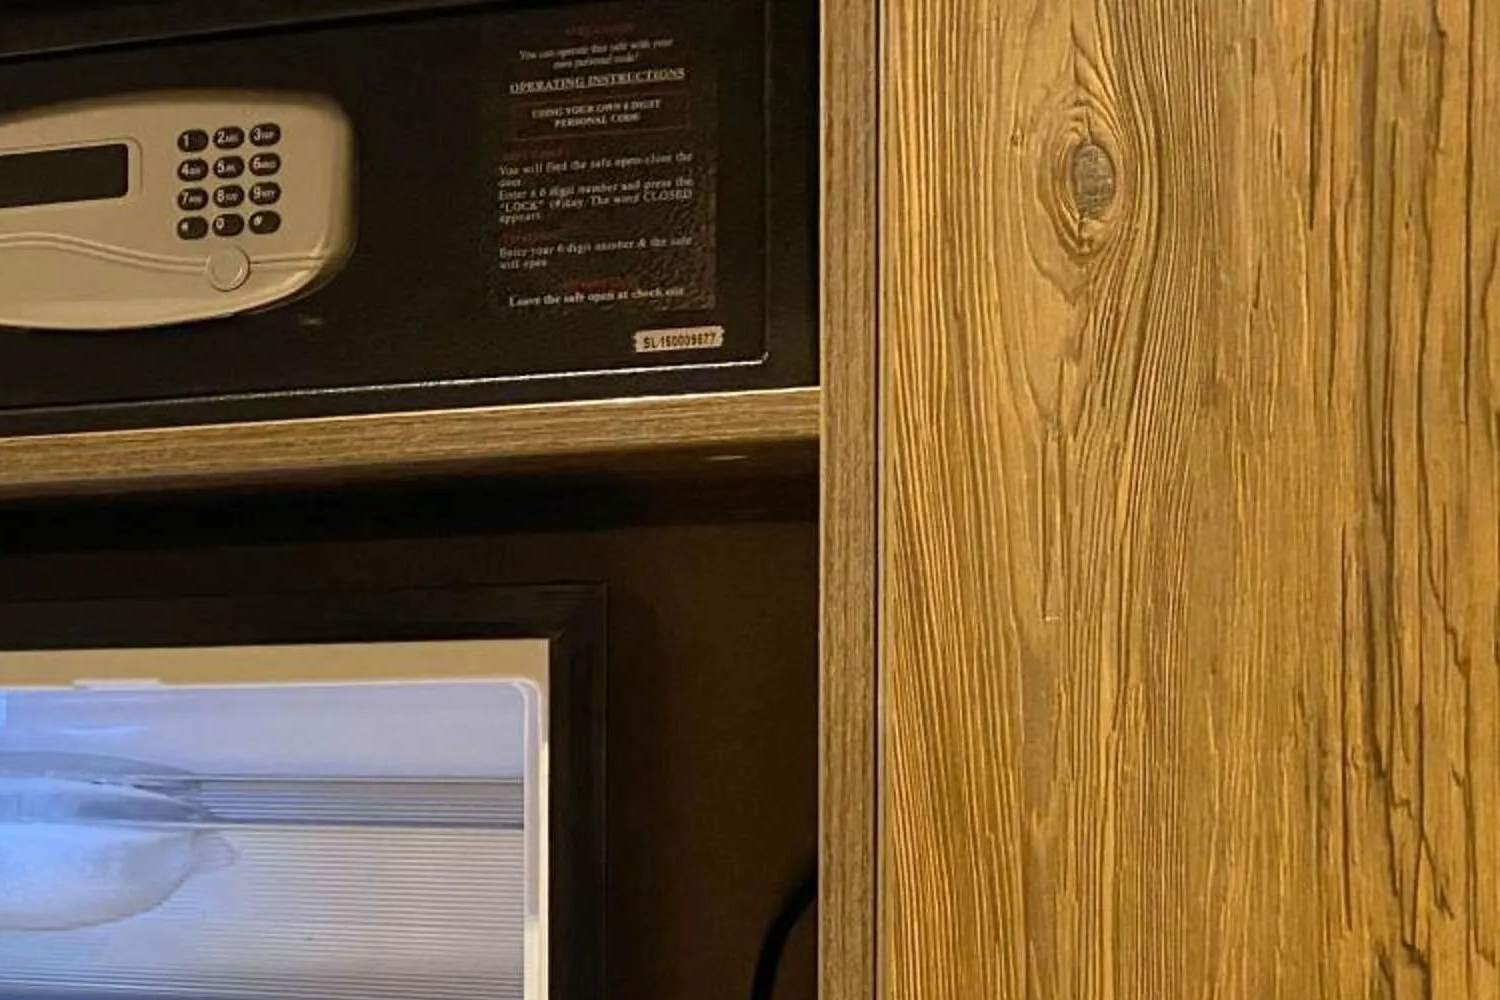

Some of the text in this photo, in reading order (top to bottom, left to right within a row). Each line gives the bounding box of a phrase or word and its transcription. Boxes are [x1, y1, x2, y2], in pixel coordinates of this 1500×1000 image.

[509, 67, 686, 94] OPERATING INSTRUCTIONS
[643, 188, 693, 202] CLOSED
